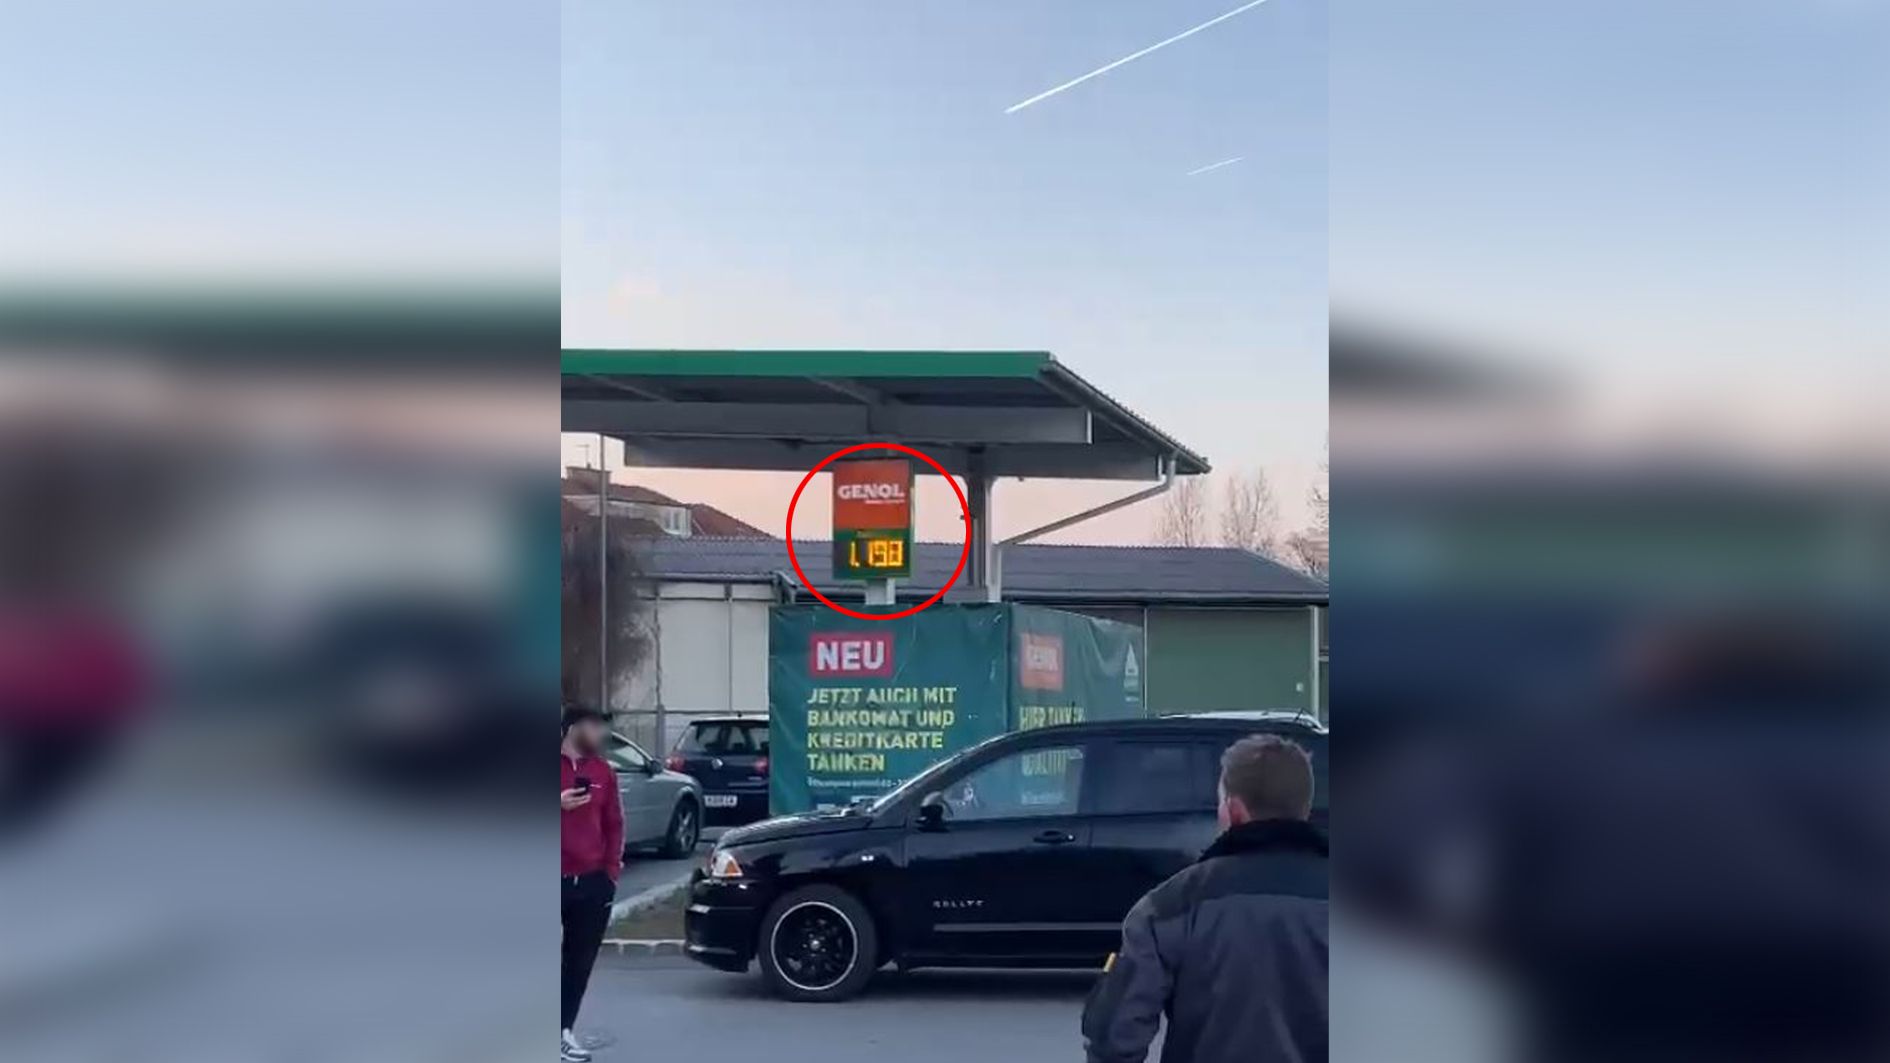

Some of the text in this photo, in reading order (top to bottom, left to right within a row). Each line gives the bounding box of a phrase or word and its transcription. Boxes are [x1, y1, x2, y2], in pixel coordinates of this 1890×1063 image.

[838, 483, 905, 499] GENOL
[816, 641, 885, 671] NEU
[807, 687, 957, 704] JETZT AUCH MIT
[807, 710, 955, 727] BANKOMAT UND
[807, 731, 944, 749] KREDITKARTE
[807, 753, 885, 771] TANKEN
